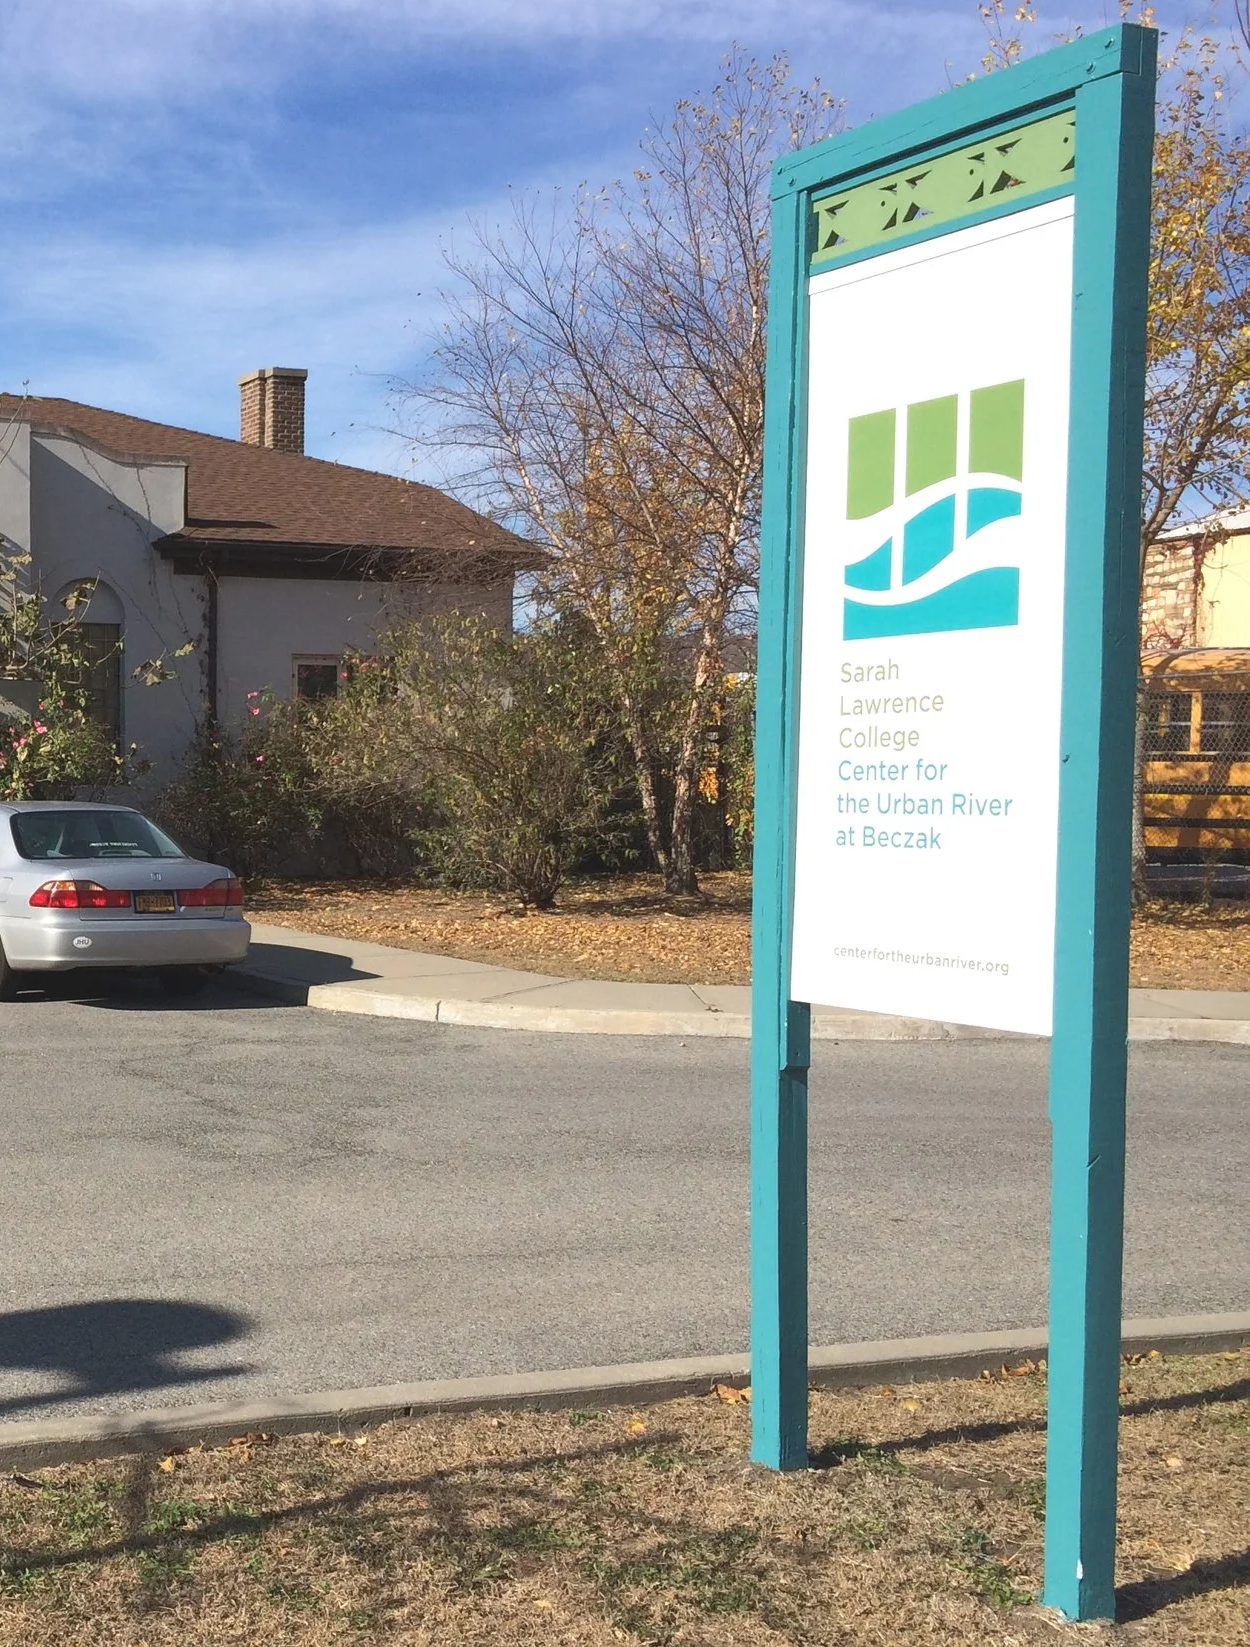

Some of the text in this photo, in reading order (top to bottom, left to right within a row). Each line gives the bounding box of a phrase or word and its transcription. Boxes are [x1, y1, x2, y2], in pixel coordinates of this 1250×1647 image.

[840, 658, 900, 683] Sarah
[839, 693, 945, 716] Lawrence
[839, 726, 920, 751] College
[838, 758, 948, 782] Center for
[836, 793, 1013, 816] the Urban River
[835, 826, 942, 849] at Beczak
[833, 945, 1011, 976] centerfortheurbanriver.org
